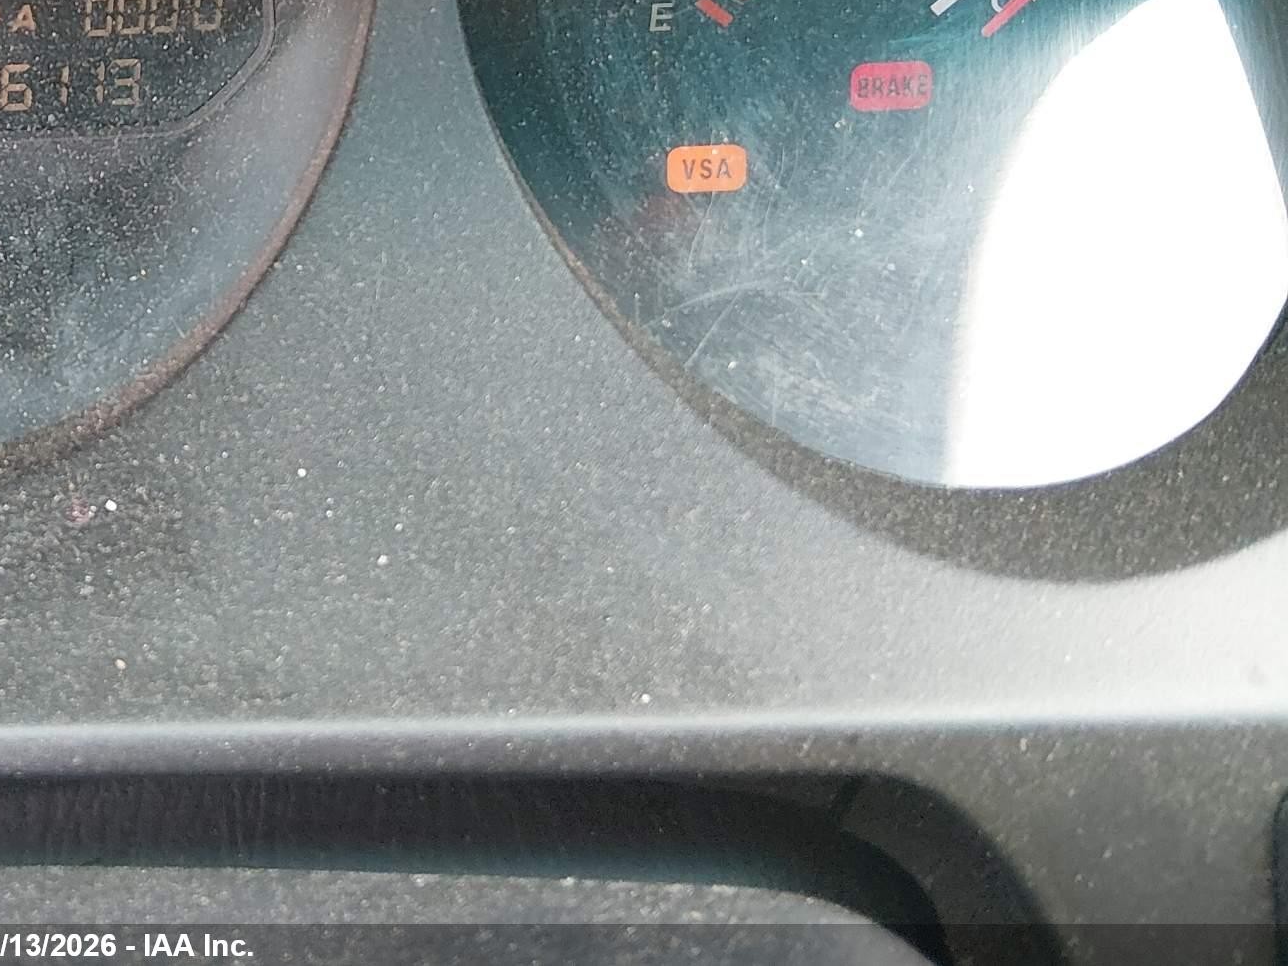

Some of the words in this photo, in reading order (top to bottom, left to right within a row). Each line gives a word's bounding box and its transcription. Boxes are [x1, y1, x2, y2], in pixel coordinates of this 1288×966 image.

[7, 4, 37, 34] A
[649, 2, 674, 32] E
[857, 74, 929, 99] BRAKE
[681, 153, 732, 181] VSA
